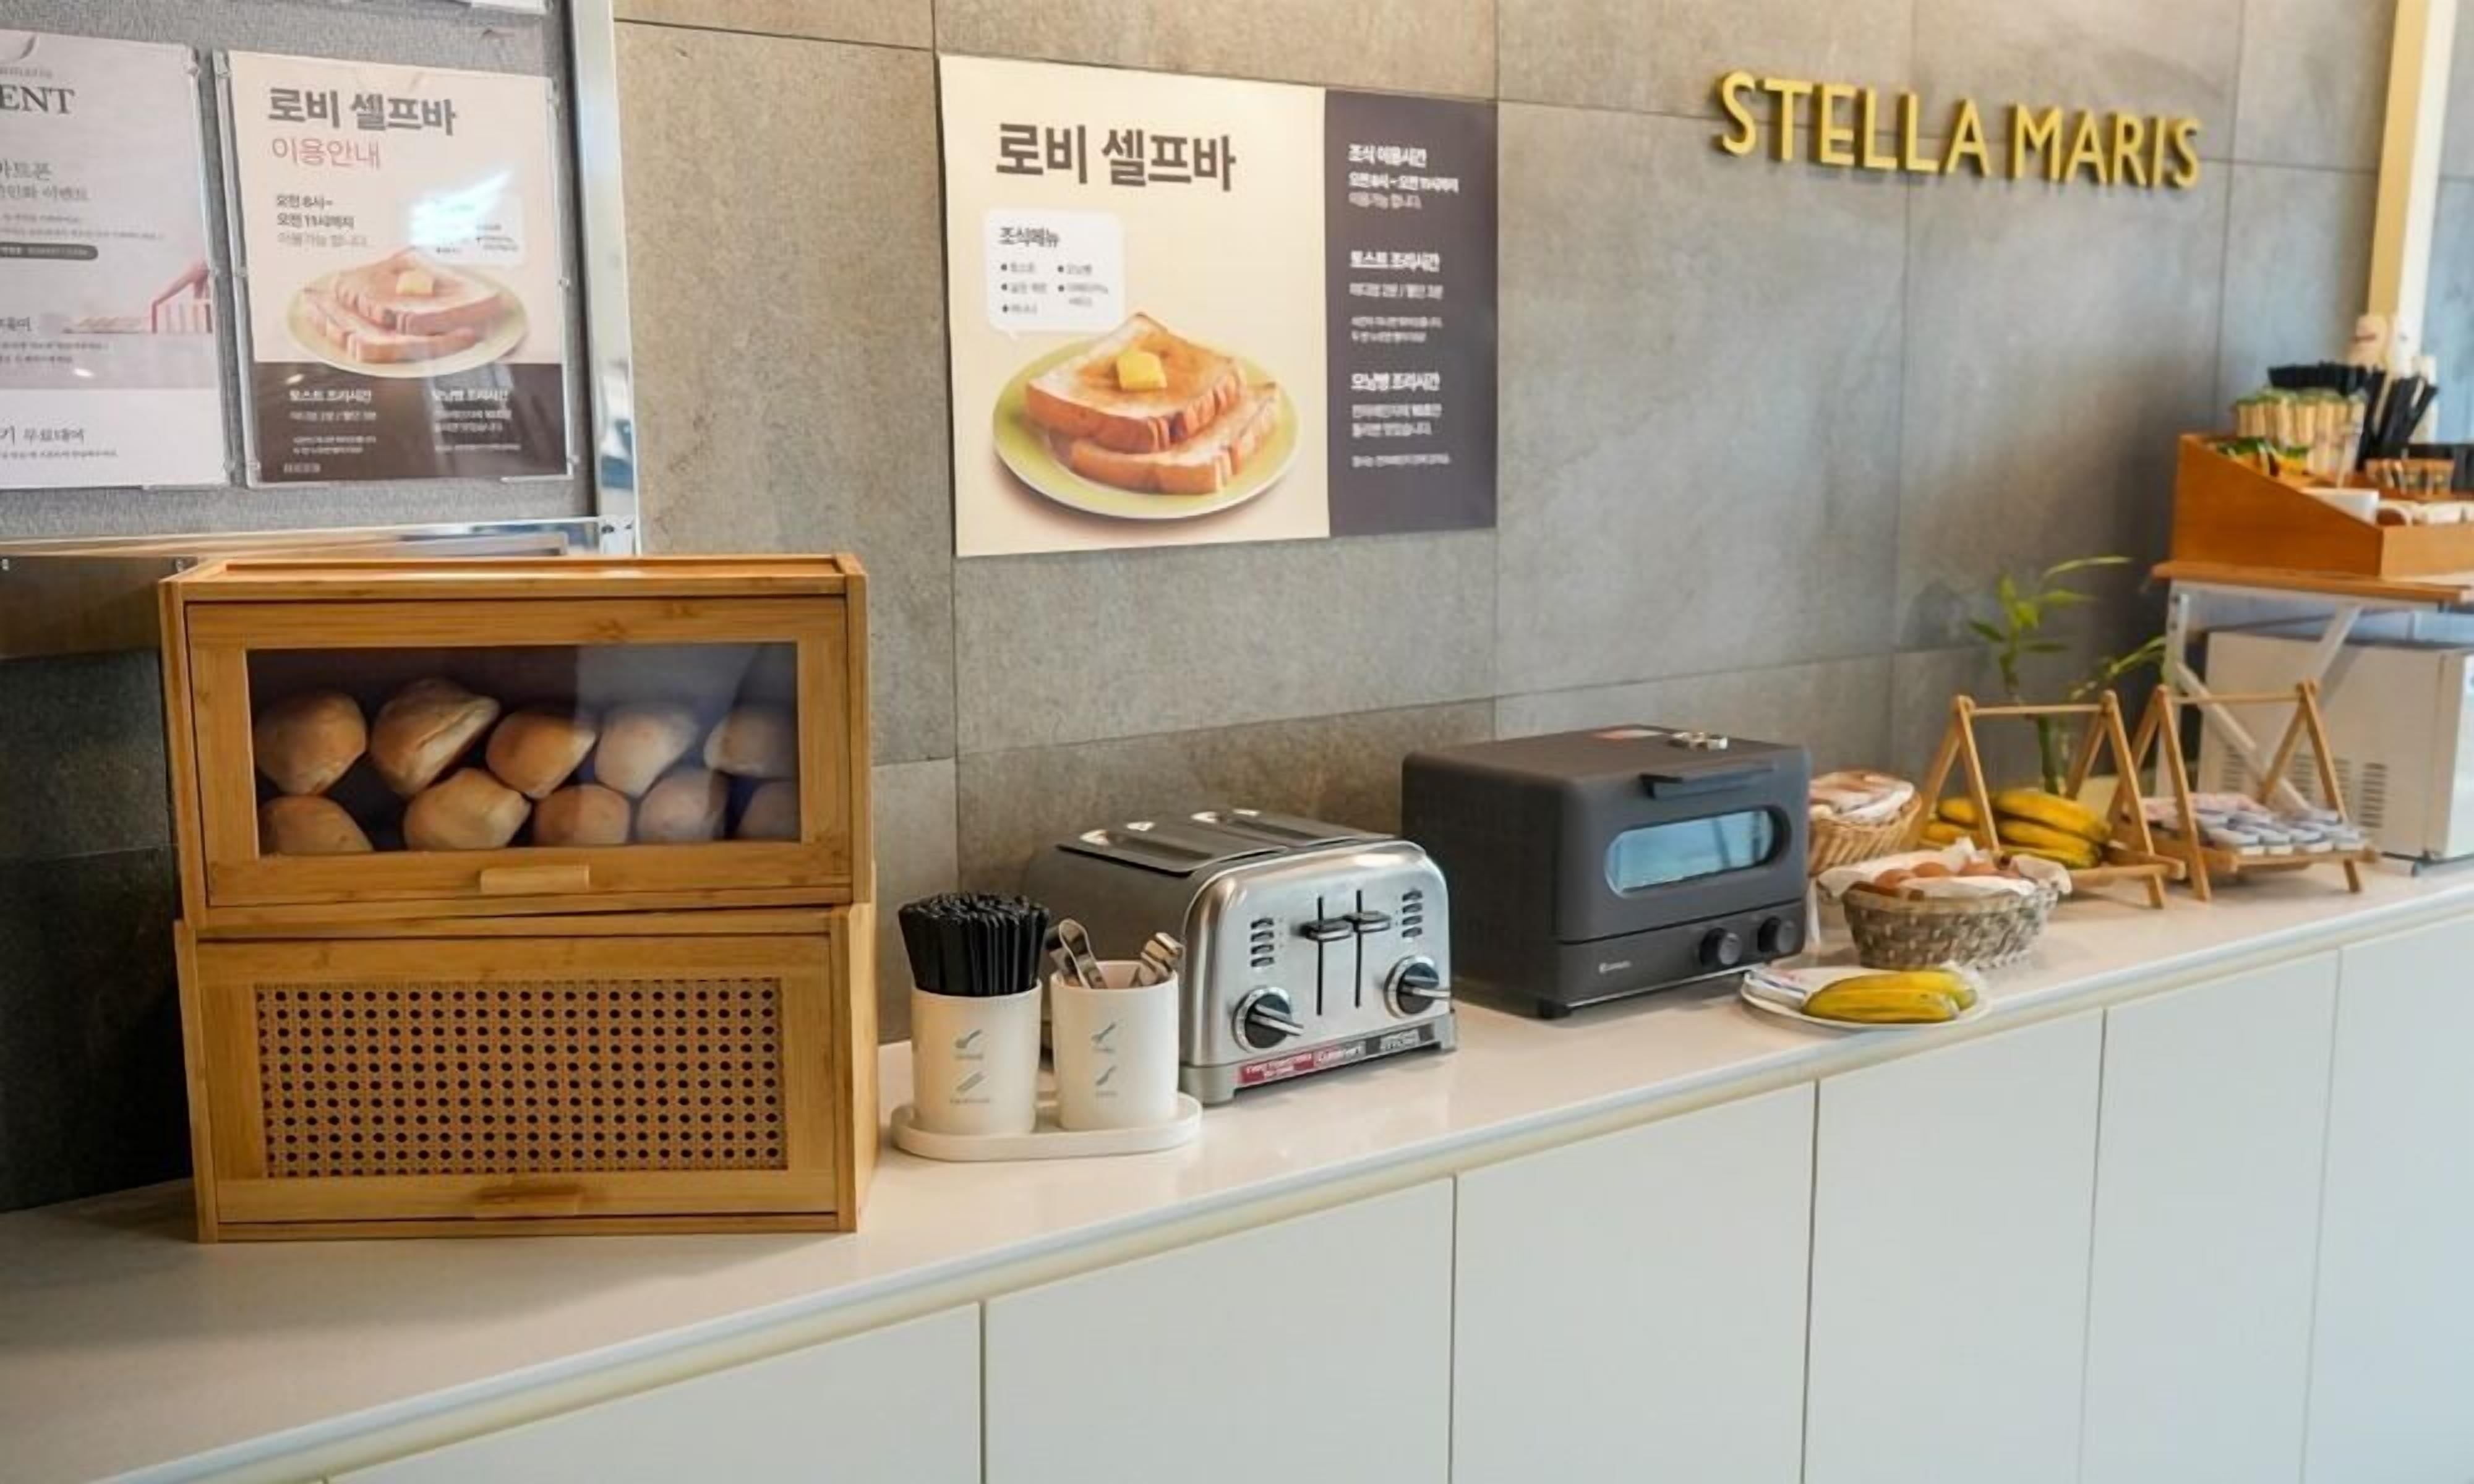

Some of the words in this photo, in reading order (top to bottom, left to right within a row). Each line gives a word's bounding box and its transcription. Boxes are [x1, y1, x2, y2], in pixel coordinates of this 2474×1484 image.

[0, 83, 75, 114] ENT
[268, 87, 340, 128] 로비
[351, 93, 457, 136] 셀프바
[272, 137, 382, 169] 이용안내
[1717, 70, 1991, 176] STELLA
[2008, 103, 2202, 189] MARIS
[996, 122, 1087, 184] 로비
[1101, 129, 1236, 192] 셀프바
